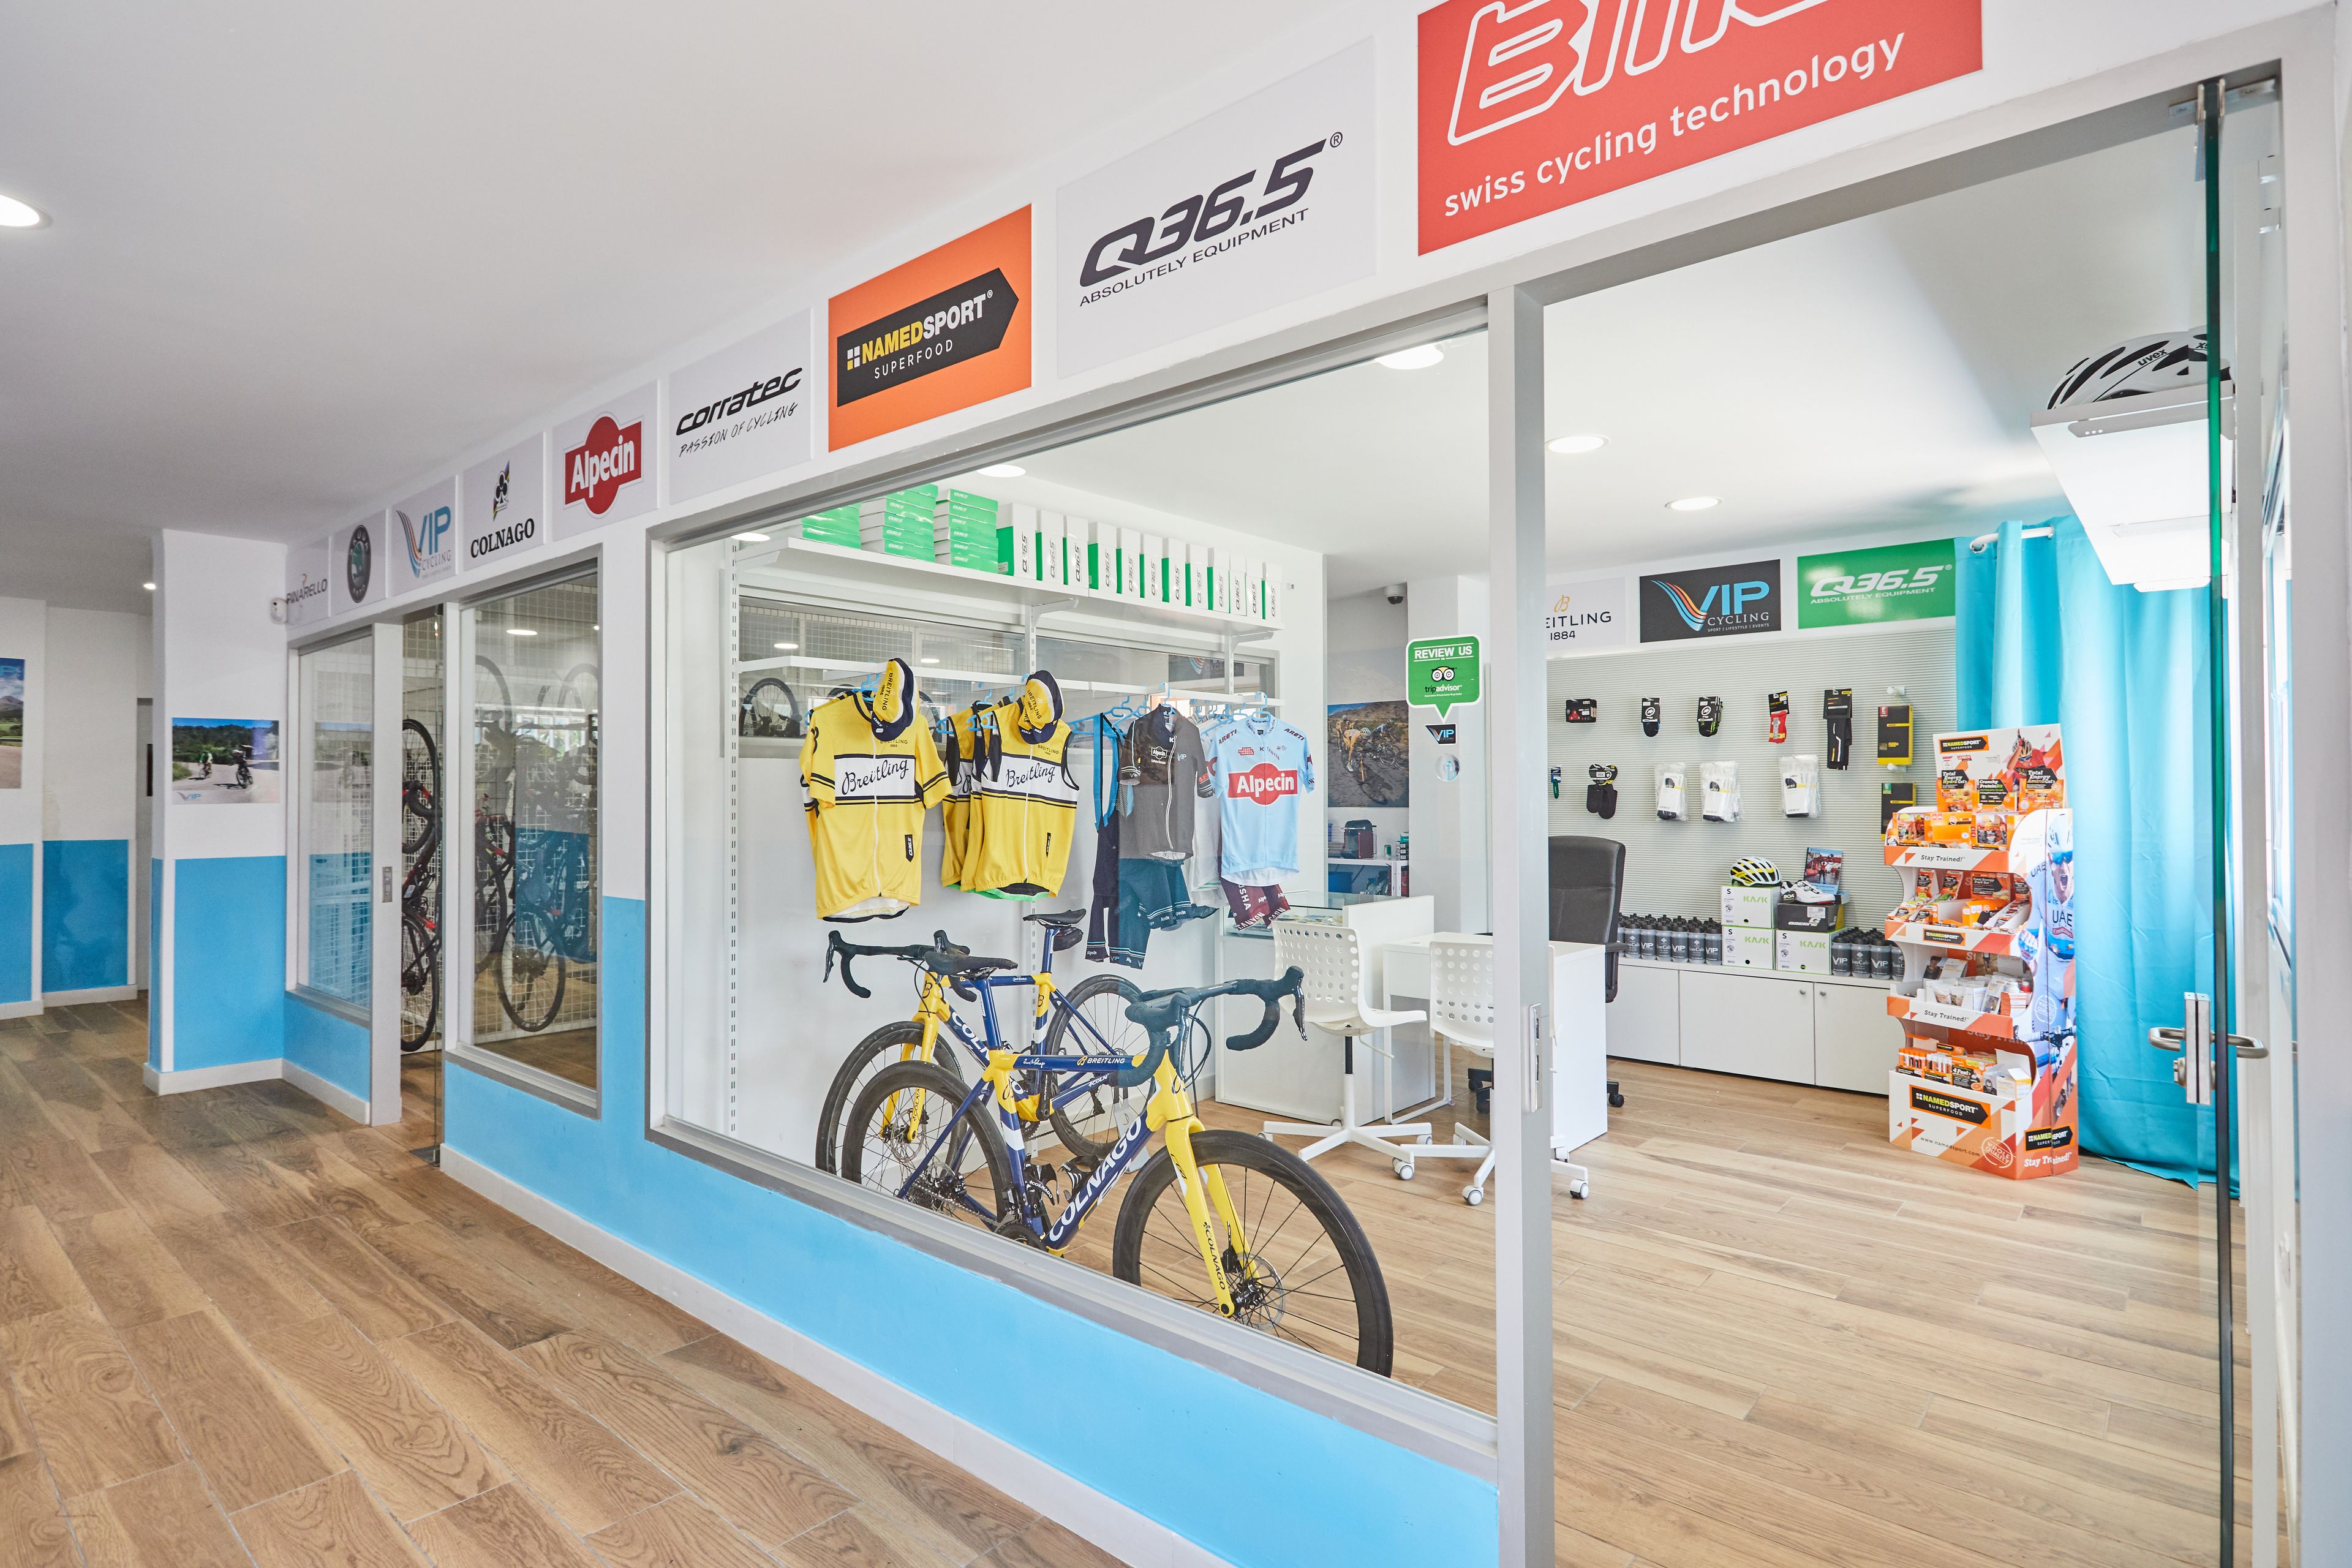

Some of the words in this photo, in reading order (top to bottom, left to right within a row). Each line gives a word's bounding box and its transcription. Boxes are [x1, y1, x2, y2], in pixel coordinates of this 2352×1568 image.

[1445, 168, 1526, 217] swiss
[1536, 121, 1657, 186] cycling
[1670, 31, 1905, 137] technology
[1080, 256, 1187, 307] ABSOLUTELY
[1193, 208, 1309, 263] EQUIPMENT
[874, 339, 953, 379] SUPERFOOD
[2138, 348, 2168, 366] uvex
[676, 368, 803, 436] corratec
[679, 429, 728, 458] PASSION
[731, 421, 745, 438] OF
[746, 402, 799, 432] CYCLING
[570, 435, 636, 494] Alpecin
[396, 505, 451, 579] VIP
[470, 518, 535, 559] COLNAGO
[421, 549, 452, 571] CYCLING
[286, 578, 328, 605] PINARELLO
[1811, 594, 1872, 604] ABSOLUTELY
[1875, 587, 1936, 598] EQUIPMENT
[1651, 579, 1770, 631] VIP
[1546, 611, 1611, 628] EITLING
[1707, 612, 1770, 626] CYCLING
[1551, 630, 1576, 641] 1884
[1414, 647, 1455, 660] REVIEW
[1458, 645, 1473, 656] US
[1425, 684, 1461, 693] tripadvisor
[1428, 728, 1455, 742] VIP
[1038, 744, 1059, 755] BREITLING
[842, 759, 910, 795] Breitling
[1006, 763, 1056, 788] Breitling
[1237, 772, 1294, 797] Alpecin
[2031, 862, 2046, 878] UAE
[1237, 911, 1265, 930] CANYON
[2052, 910, 2073, 927] UAE
[1672, 944, 1686, 952] VIP
[1744, 936, 1770, 944] KASK
[1800, 940, 1826, 949] KASK
[1832, 956, 1848, 965] VIP
[1871, 957, 1888, 968] VIP
[1924, 1009, 1938, 1018] Stay
[1939, 1012, 1967, 1022] Trained!
[1928, 1104, 1963, 1117] SUPERFOOD
[1920, 1136, 1980, 1158] www.namedsport.com
[1985, 1145, 2010, 1166] QUALITY
[1986, 1140, 2010, 1160] WHOLE
[2024, 1158, 2040, 1167] Stay
[1049, 1116, 1142, 1242] COLNAGO
[1032, 1181, 1053, 1199] COLNAGO
[1205, 1228, 1226, 1291] COLNAGO
